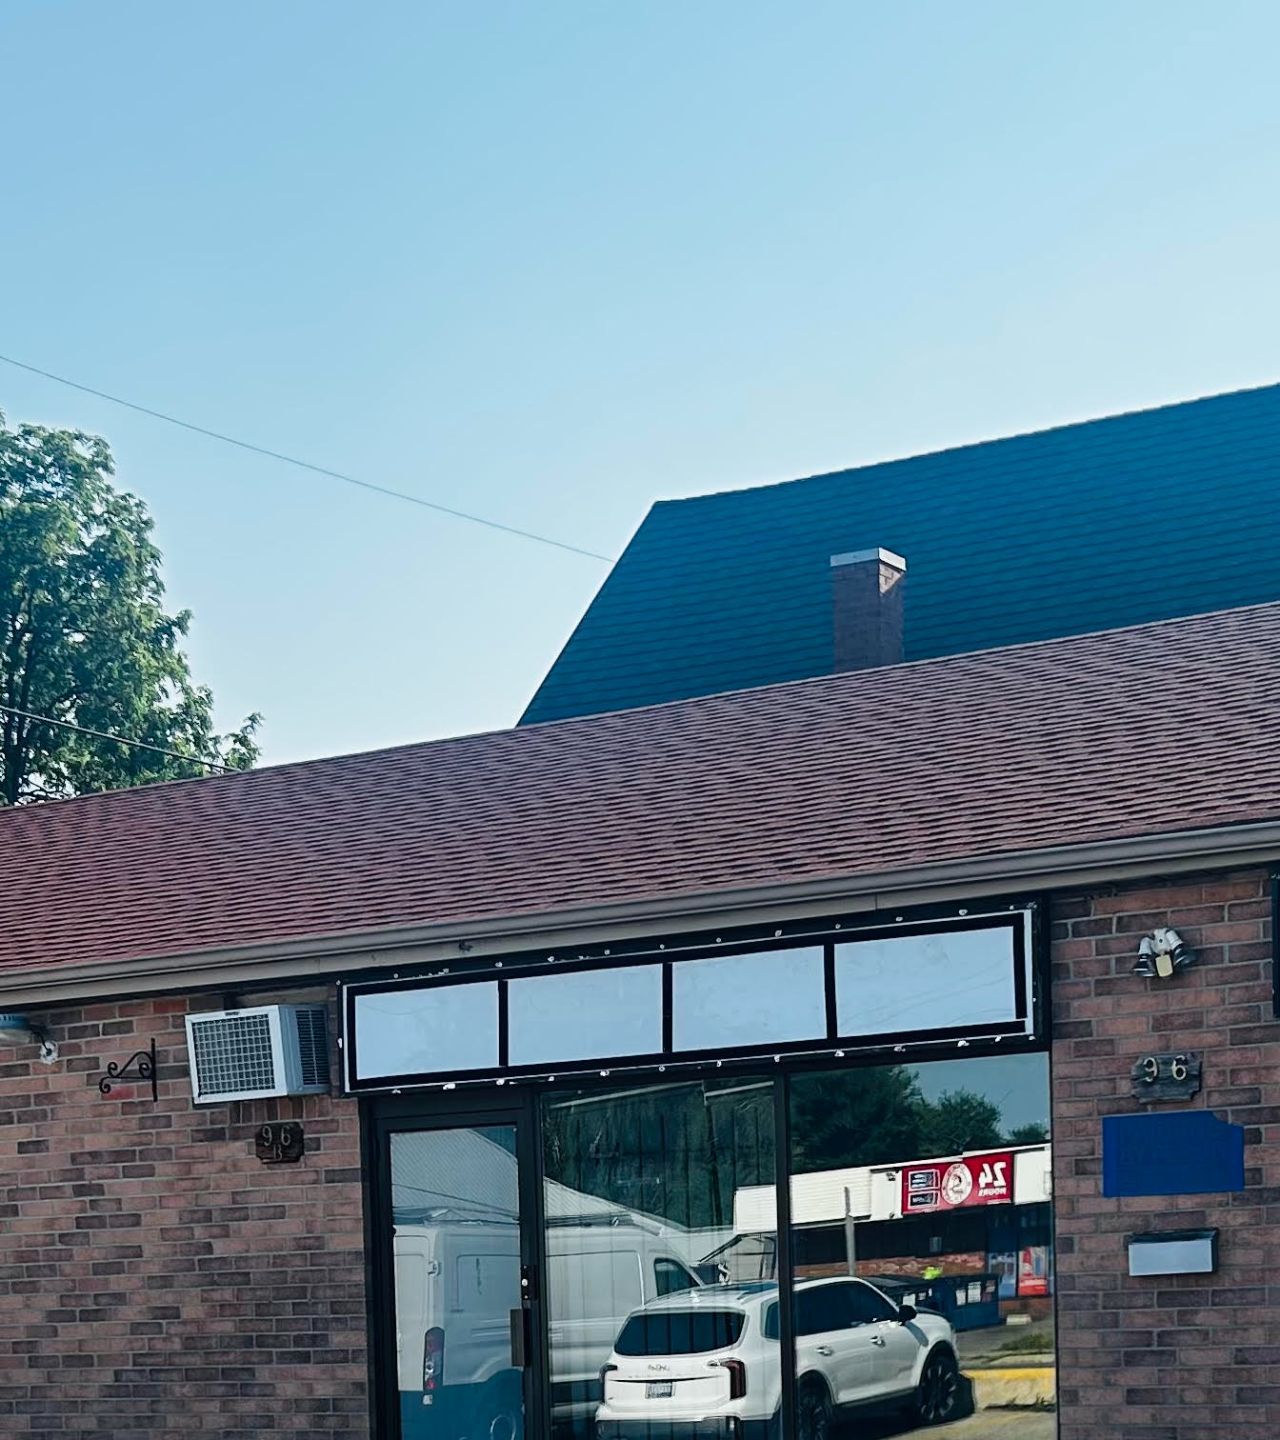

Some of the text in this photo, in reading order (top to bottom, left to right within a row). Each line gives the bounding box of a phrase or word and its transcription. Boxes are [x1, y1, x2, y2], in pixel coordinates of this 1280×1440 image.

[1143, 1055, 1187, 1082] 96
[262, 1125, 291, 1146] 96
[273, 1144, 283, 1161] B
